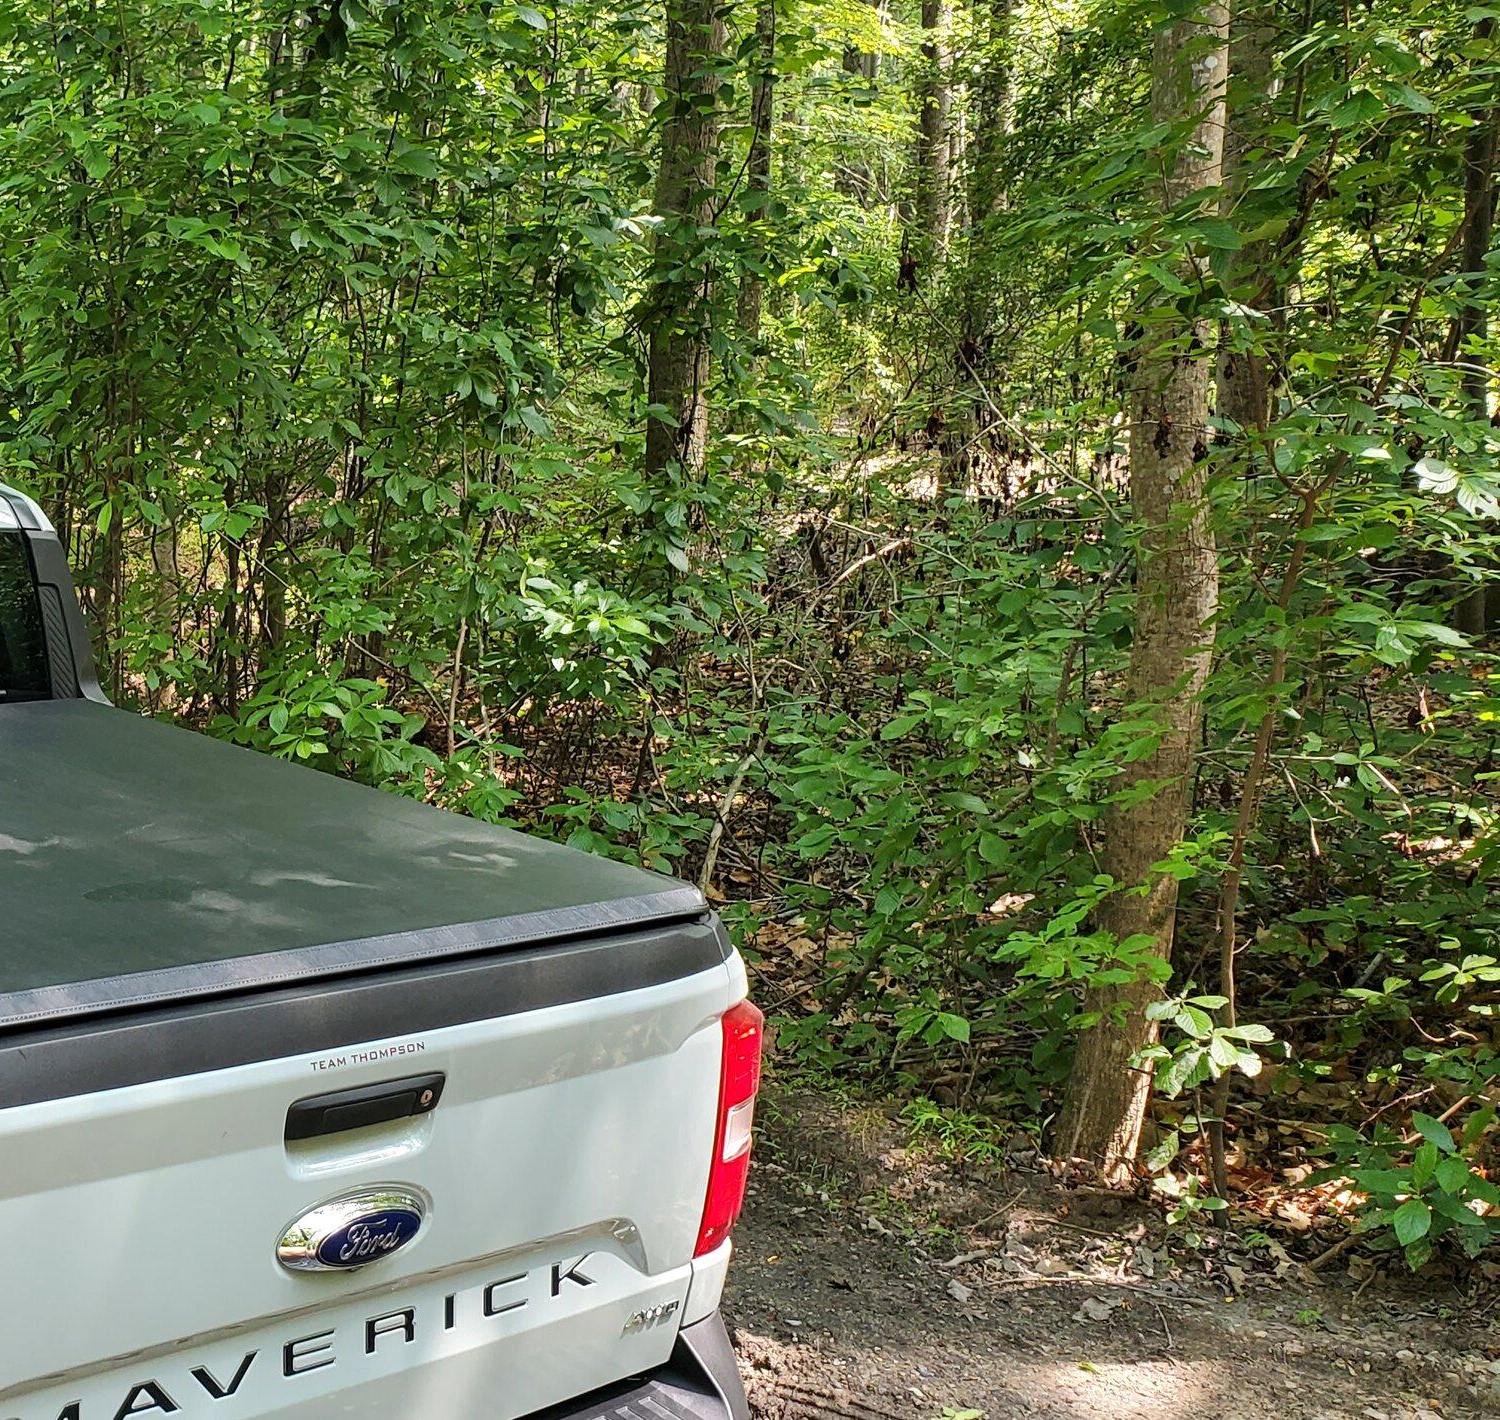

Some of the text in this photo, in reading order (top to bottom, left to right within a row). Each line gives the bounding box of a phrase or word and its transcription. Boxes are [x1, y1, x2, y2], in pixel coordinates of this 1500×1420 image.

[310, 1041, 425, 1071] TEAM THOMPSON
[340, 1219, 401, 1260] Ford
[3, 1250, 597, 1420] AVERICK
